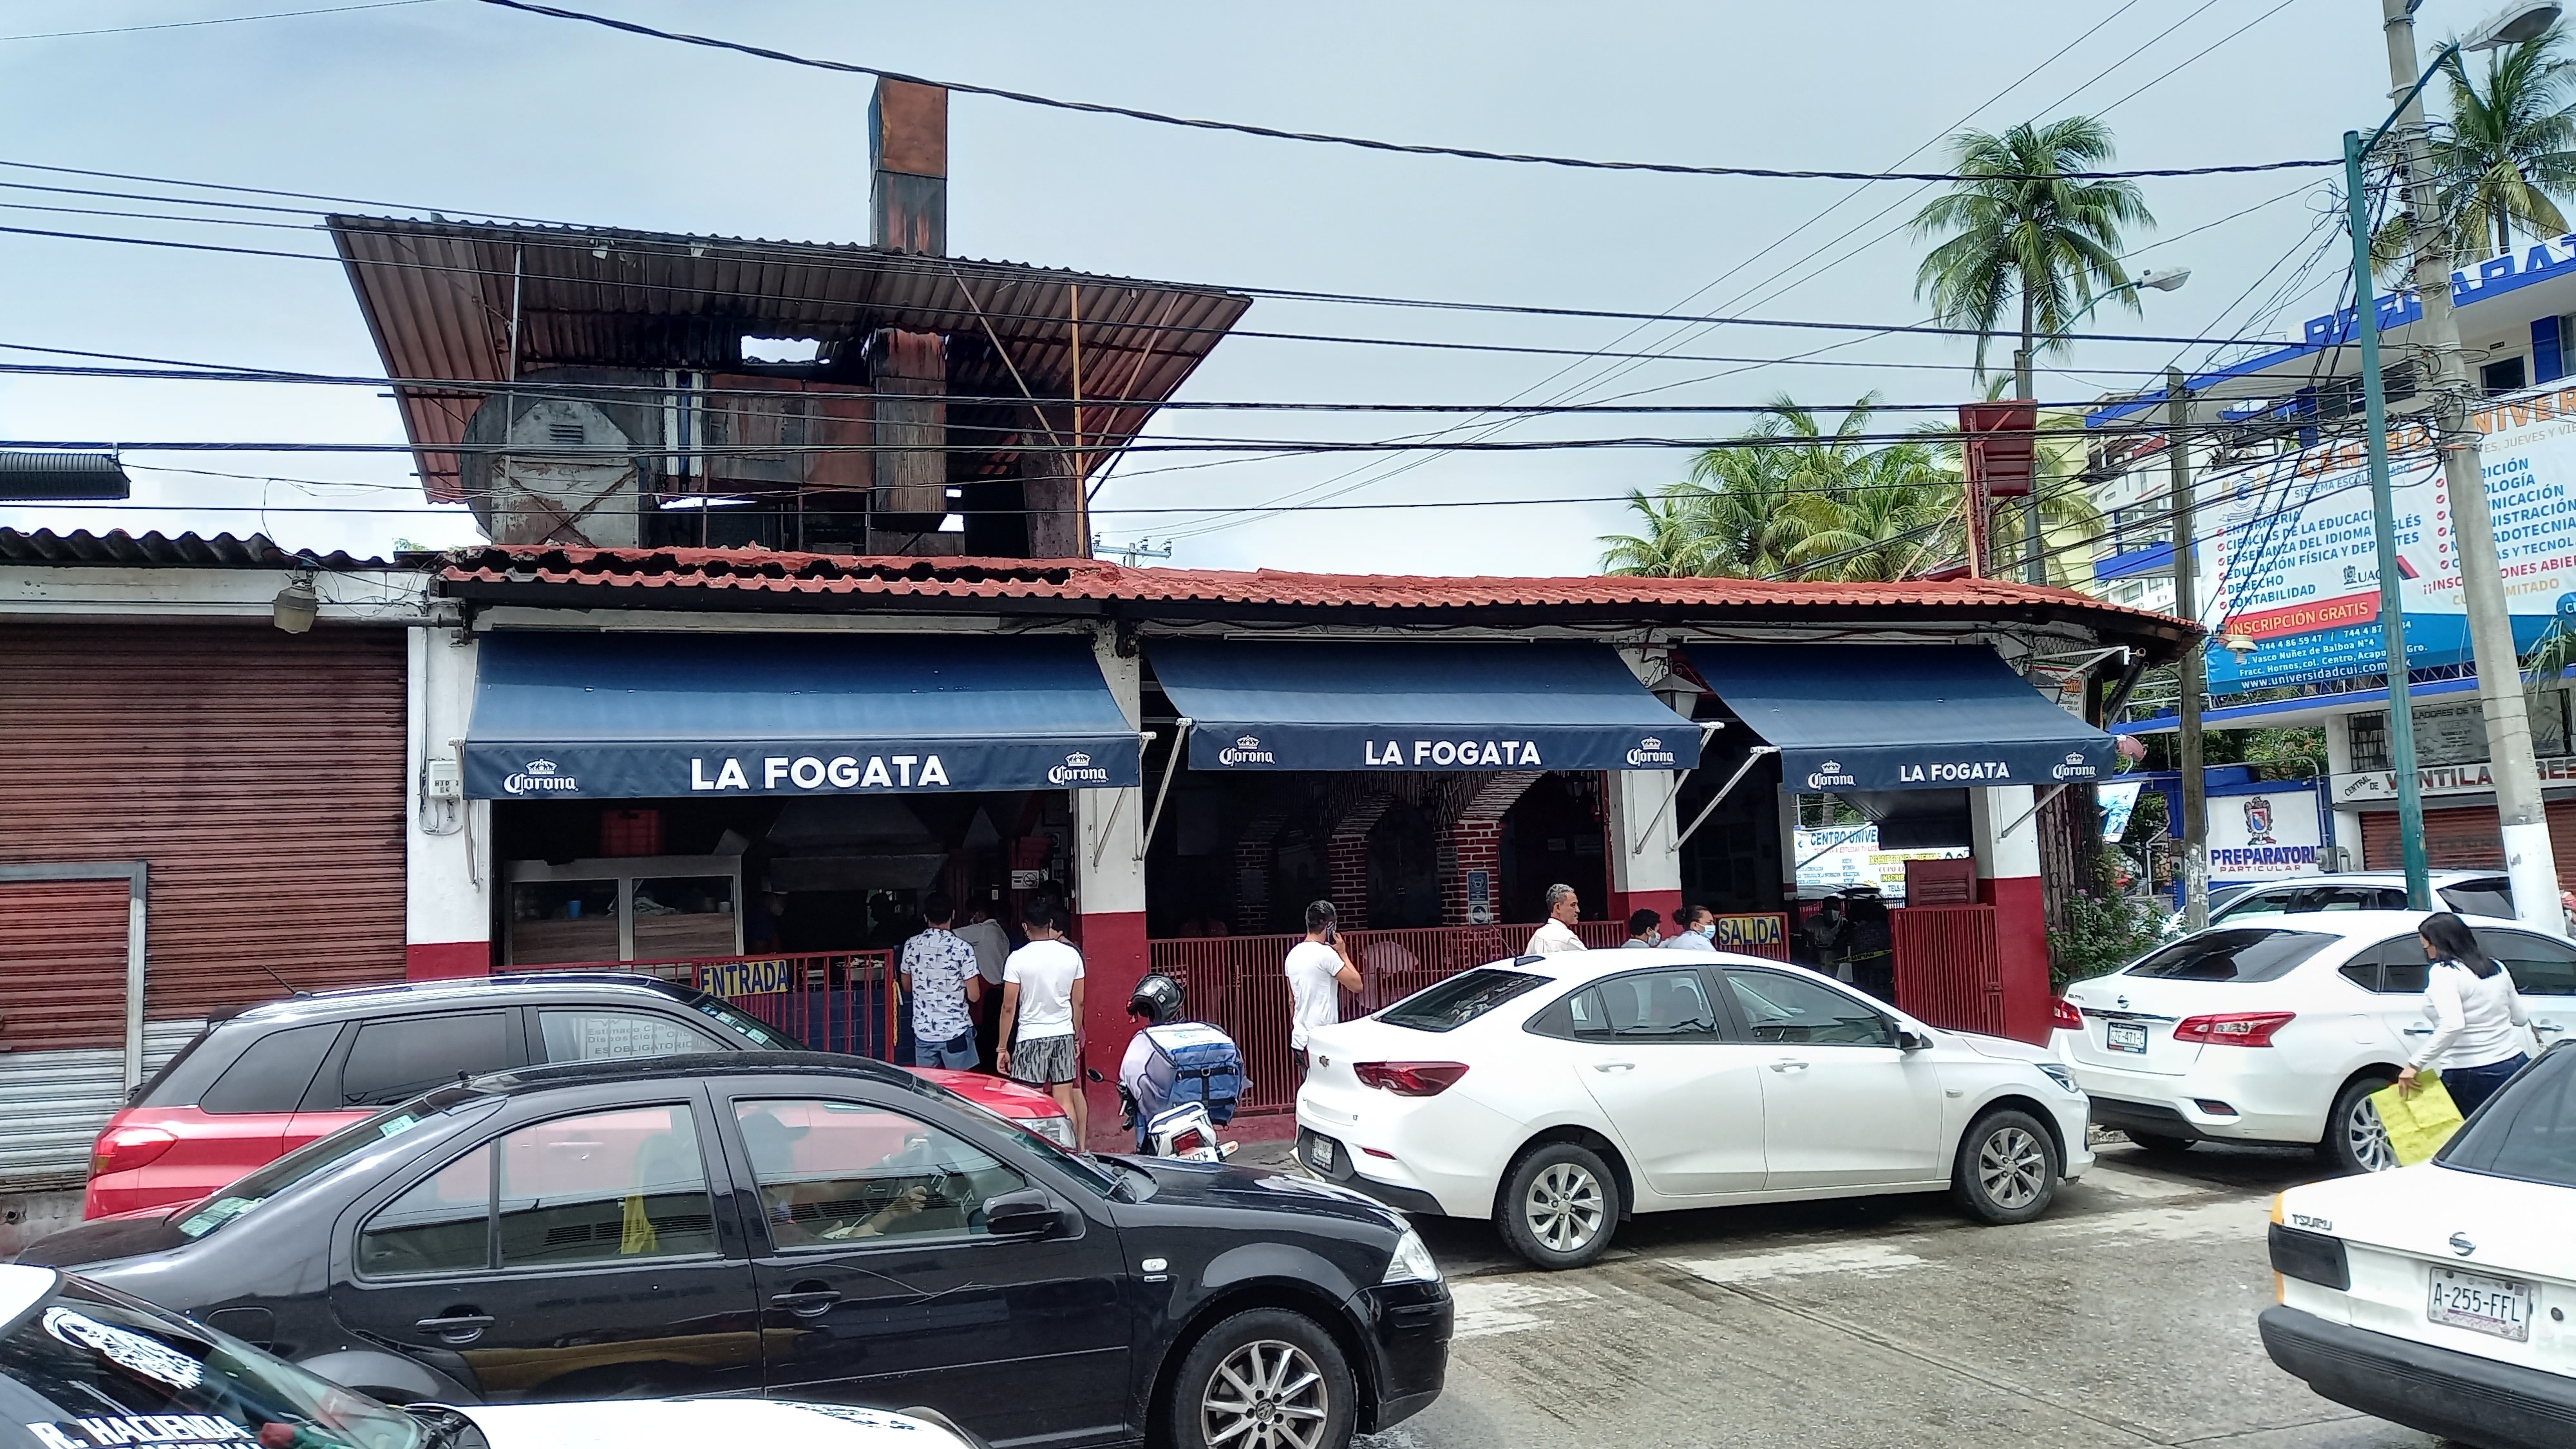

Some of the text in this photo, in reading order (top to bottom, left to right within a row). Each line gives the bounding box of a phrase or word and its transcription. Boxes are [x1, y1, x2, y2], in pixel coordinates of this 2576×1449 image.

[2299, 388, 2576, 479] CENRO NIVER
[2505, 431, 2546, 449] JUEVES
[2548, 428, 2555, 438] Y
[2481, 457, 2529, 479] RICIÓN
[2295, 480, 2334, 498] SISTEMA
[2484, 472, 2535, 495] OLOGÍA
[2282, 526, 2298, 539] DE
[2301, 522, 2316, 535] LA
[2319, 509, 2372, 531] EDUCACI
[2300, 536, 2322, 551] DEL
[2325, 526, 2372, 545] IDIOMA
[2392, 513, 2421, 532] GLÉS
[2299, 550, 2338, 565] FÍSICA
[2340, 545, 2349, 557] Y
[2512, 546, 2520, 557] Y
[2228, 574, 2284, 594] DERECHO
[2505, 578, 2560, 598] MITADO
[2229, 584, 2316, 608] CONTABILIDAD
[2230, 601, 2369, 636] INSCRIPCIÓN GRATIS
[2259, 642, 2276, 651] 744
[2286, 638, 2296, 647] 86
[2298, 636, 2309, 645] 59
[2311, 634, 2322, 643] 47
[2343, 628, 2360, 638] 744
[2371, 625, 2383, 634] 87
[2239, 644, 2428, 677] Fracc. Hornos, col. Centro, Acapu Gro.
[2252, 654, 2277, 664] Vasco
[2279, 649, 2307, 659] Nuñez
[2309, 647, 2320, 655] de
[2322, 643, 2354, 653] Balboa
[1218, 747, 1276, 768] Corona
[1364, 740, 1543, 766] LA FOGATA
[1625, 748, 1676, 767] Corona
[690, 755, 951, 791] LA FOGATA
[1047, 764, 1109, 786] Corona
[1807, 772, 1856, 790] Corona
[1899, 761, 2011, 782] LA FOGATA
[2052, 763, 2097, 781] Corona
[2344, 757, 2576, 797] CENTRAL DE VNTILARES
[503, 772, 579, 797] Corona
[1810, 829, 1879, 846] CENTRO UNIVE
[2210, 846, 2318, 866] PREPARATORI
[2220, 864, 2301, 873] PARTICULAR
[1718, 916, 1781, 945] SALIDA
[700, 961, 789, 998] ENTRADA
[2291, 1213, 2333, 1231] TSURU
[2433, 1283, 2521, 1323] A-255-FFL
[26, 1415, 255, 1449] R. HACIENDA
